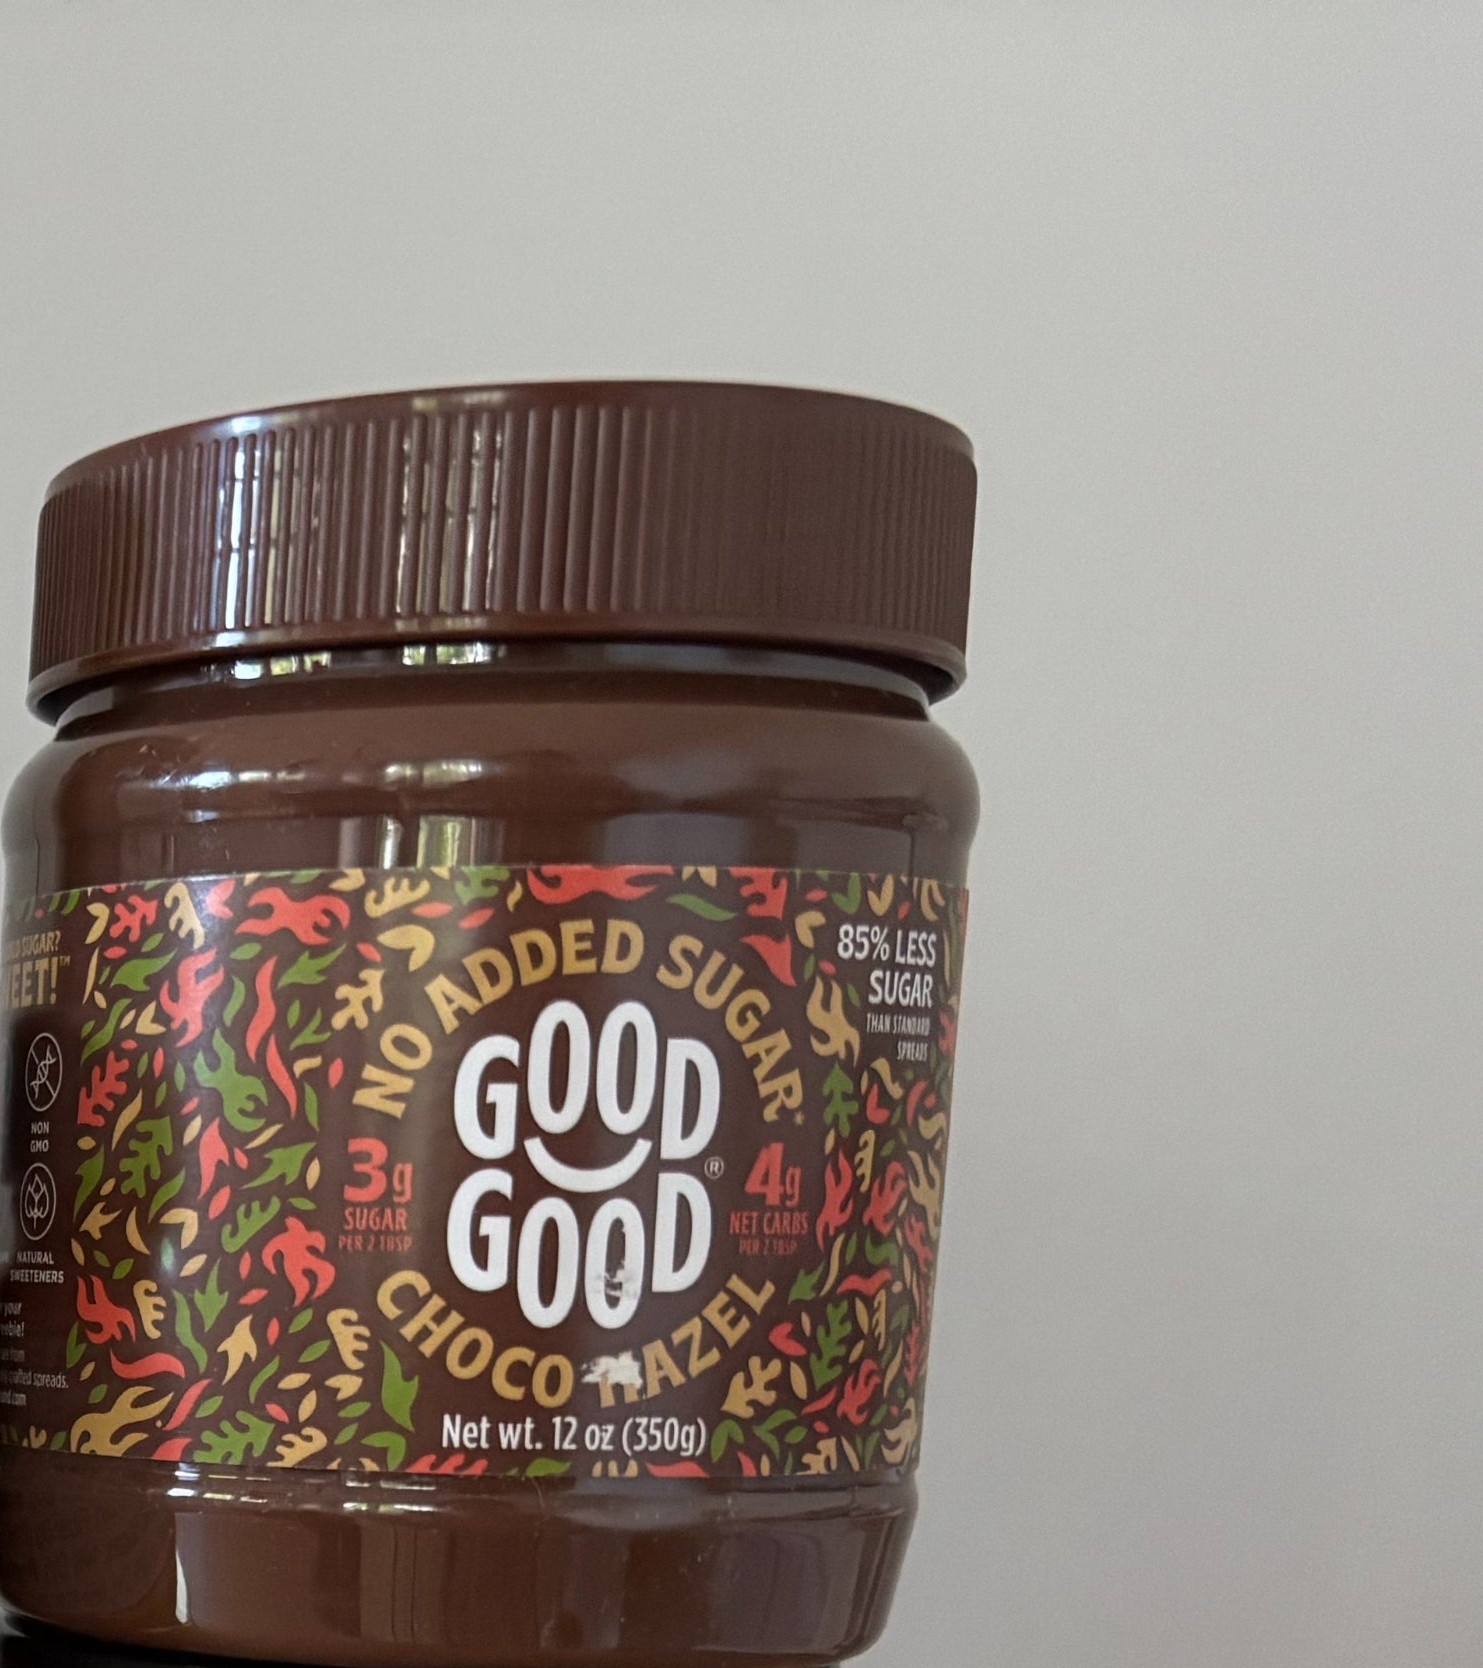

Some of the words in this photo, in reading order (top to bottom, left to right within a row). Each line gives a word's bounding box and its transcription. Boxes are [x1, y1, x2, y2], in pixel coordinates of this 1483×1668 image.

[837, 924, 890, 961] 85%
[895, 929, 937, 967] LESS
[868, 969, 933, 1008] SUGAR
[453, 1000, 721, 1160] GOOD
[343, 1137, 413, 1203] 3g
[745, 1142, 802, 1208] 4g
[343, 1207, 408, 1231] SUGAR
[729, 1211, 760, 1235] NET
[763, 1211, 809, 1235] CARBS
[447, 1168, 712, 1329] GOOD
[376, 1269, 575, 1408] CHOCO
[442, 1414, 490, 1449] Net
[498, 1420, 542, 1450] wt.
[552, 1417, 577, 1450] 12
[584, 1425, 614, 1451] oz
[622, 1416, 706, 1457] (350g)
